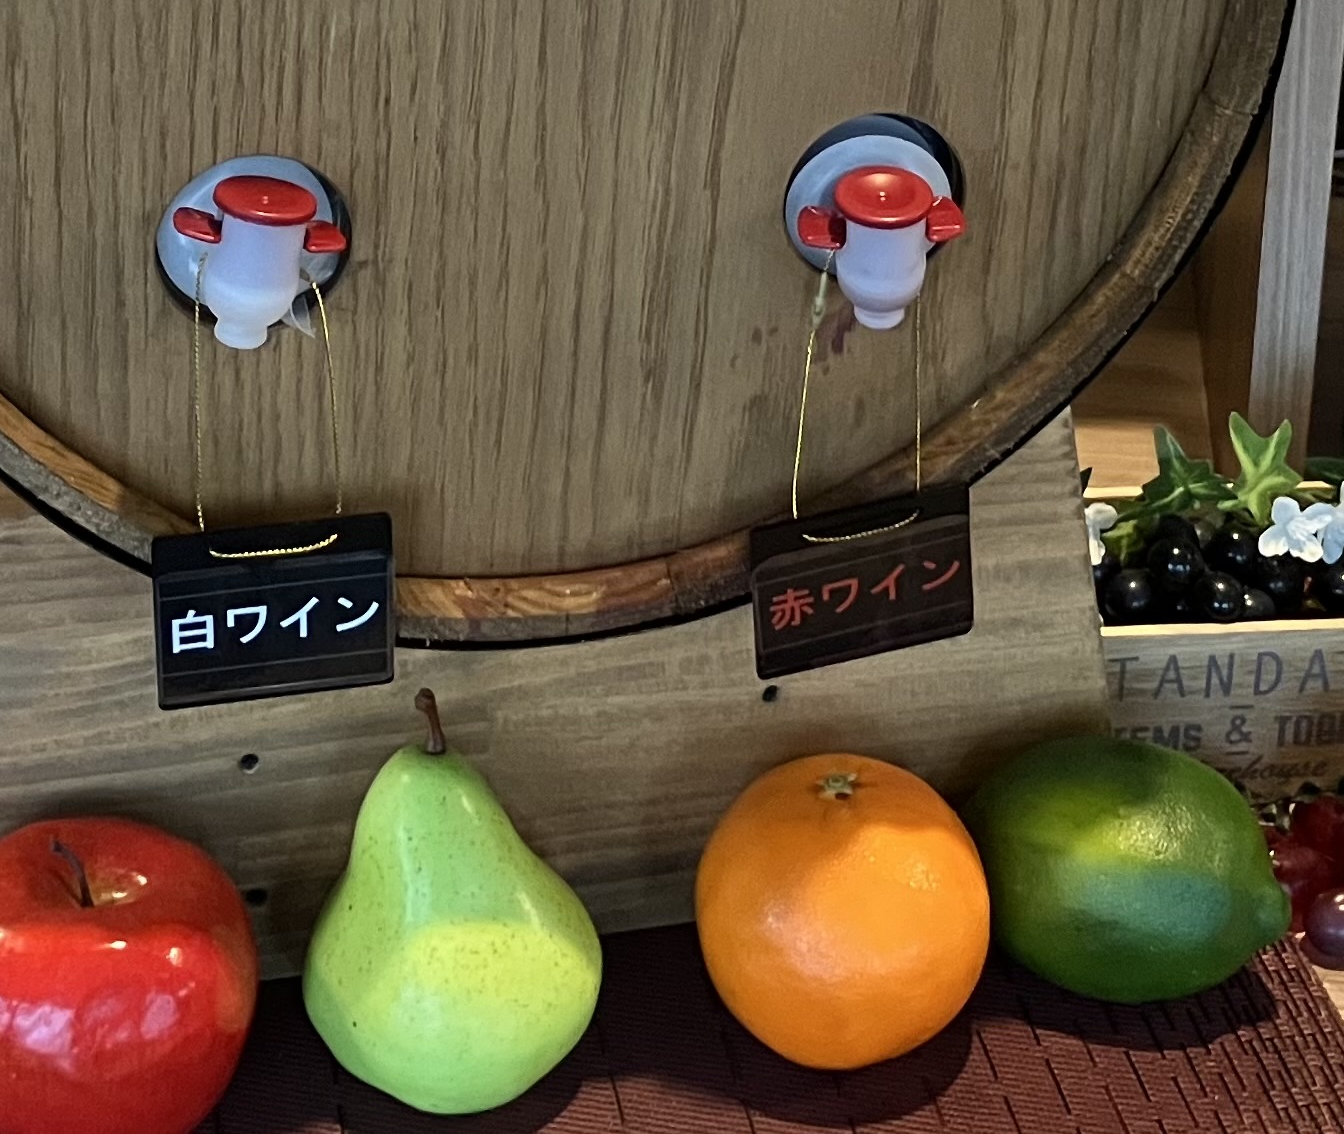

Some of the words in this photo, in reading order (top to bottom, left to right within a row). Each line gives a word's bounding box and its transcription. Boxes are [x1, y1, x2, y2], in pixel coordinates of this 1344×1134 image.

[171, 595, 380, 654] 白ワイン
[769, 559, 961, 631] 赤ワイン
[1225, 714, 1253, 744] &
